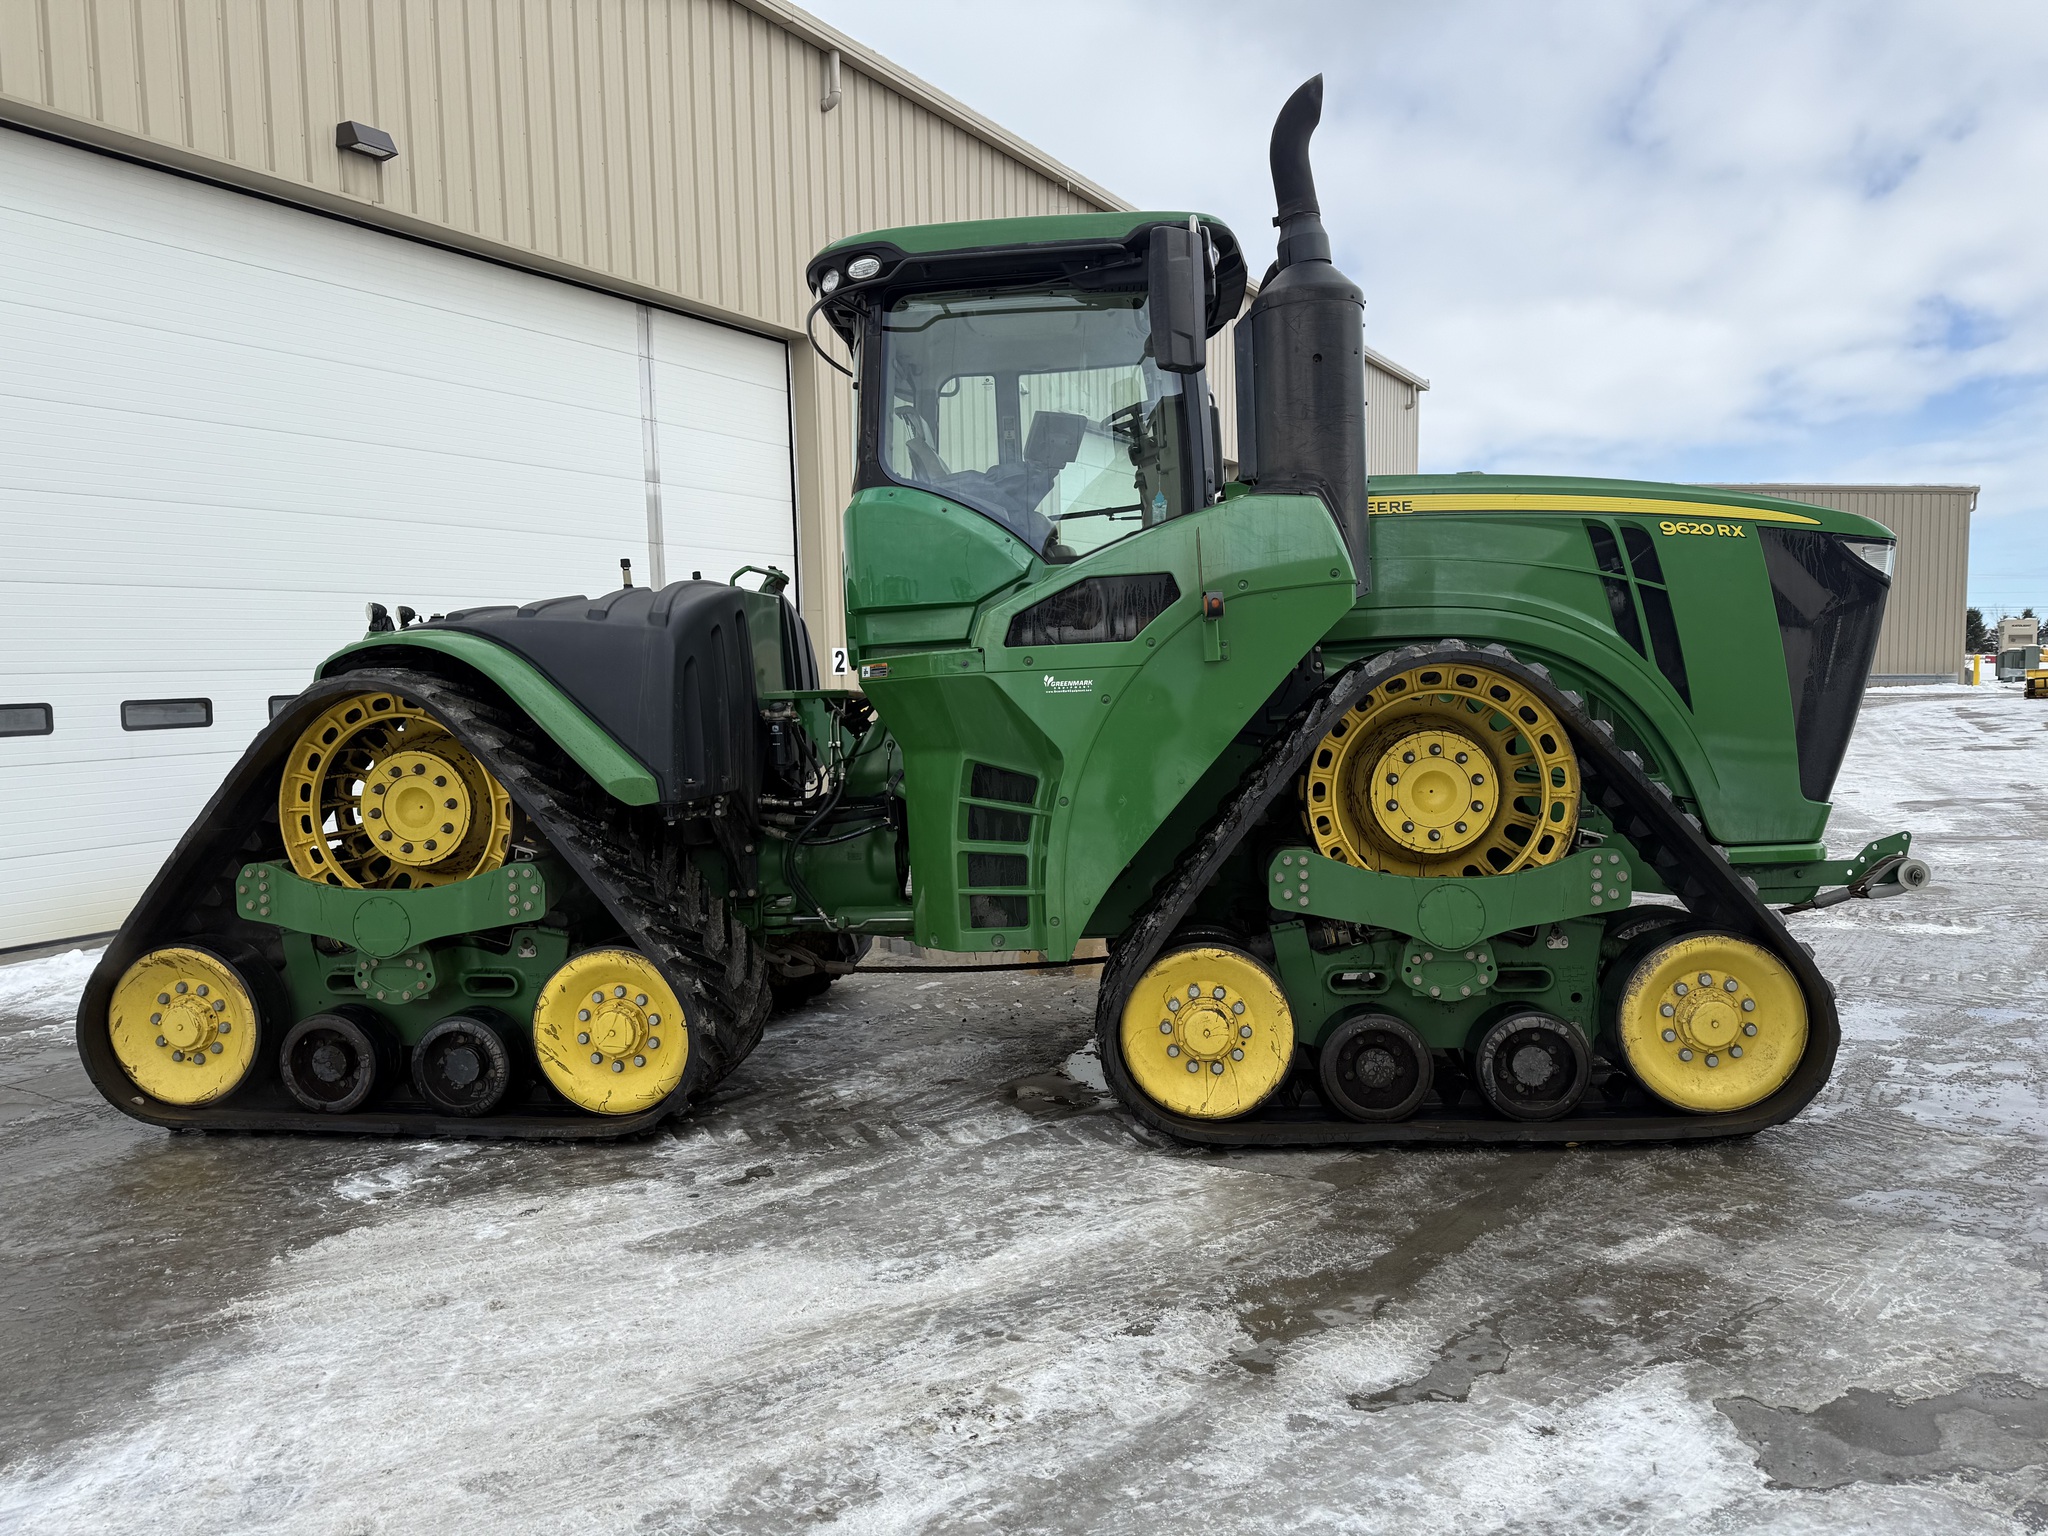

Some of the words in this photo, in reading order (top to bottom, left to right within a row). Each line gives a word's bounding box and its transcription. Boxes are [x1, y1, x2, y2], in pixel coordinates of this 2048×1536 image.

[1659, 521, 1715, 536] 9620
[1716, 524, 1746, 538] RX
[835, 650, 845, 673] 2
